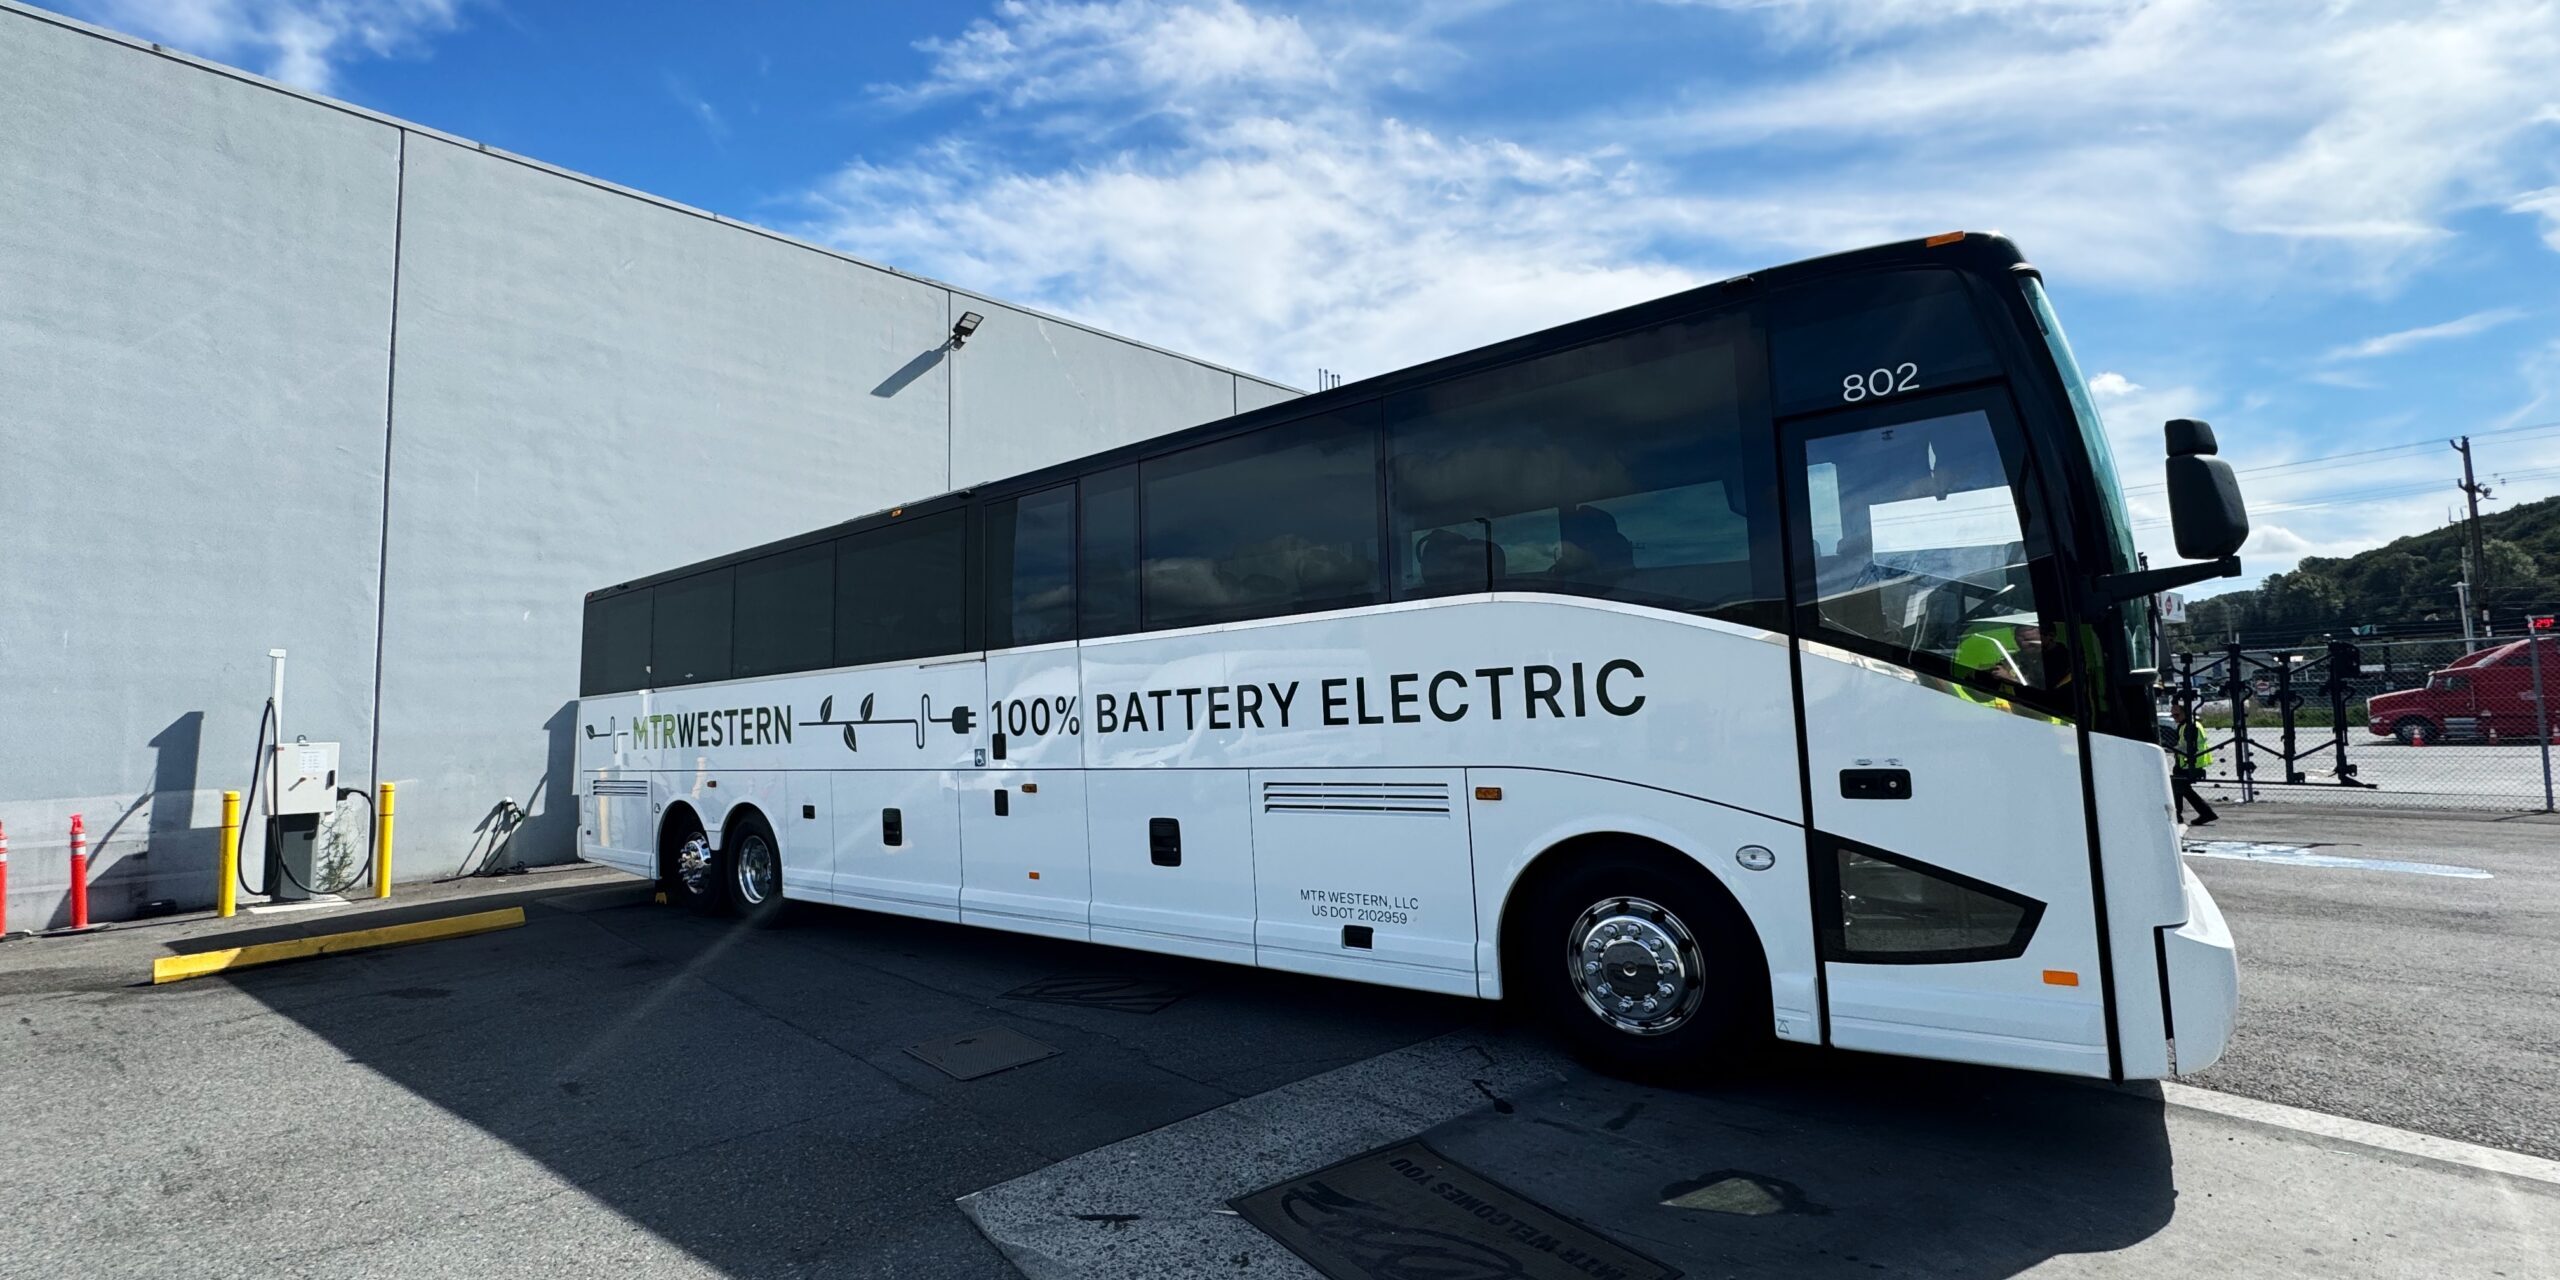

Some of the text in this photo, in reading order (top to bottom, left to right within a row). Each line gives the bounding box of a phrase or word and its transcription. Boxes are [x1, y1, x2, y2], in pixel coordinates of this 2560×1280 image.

[1843, 362, 1920, 402] 802
[991, 658, 1647, 738] 100% BATTERY ELECTRIC
[633, 704, 793, 750] MTRWESTERN
[1300, 889, 1419, 910] MTR WESTERN, LLC
[1311, 905, 1408, 924] US DOT 2102959
[1390, 1158, 1434, 1186] YOU
[1430, 1182, 1562, 1252] WELCOMES
